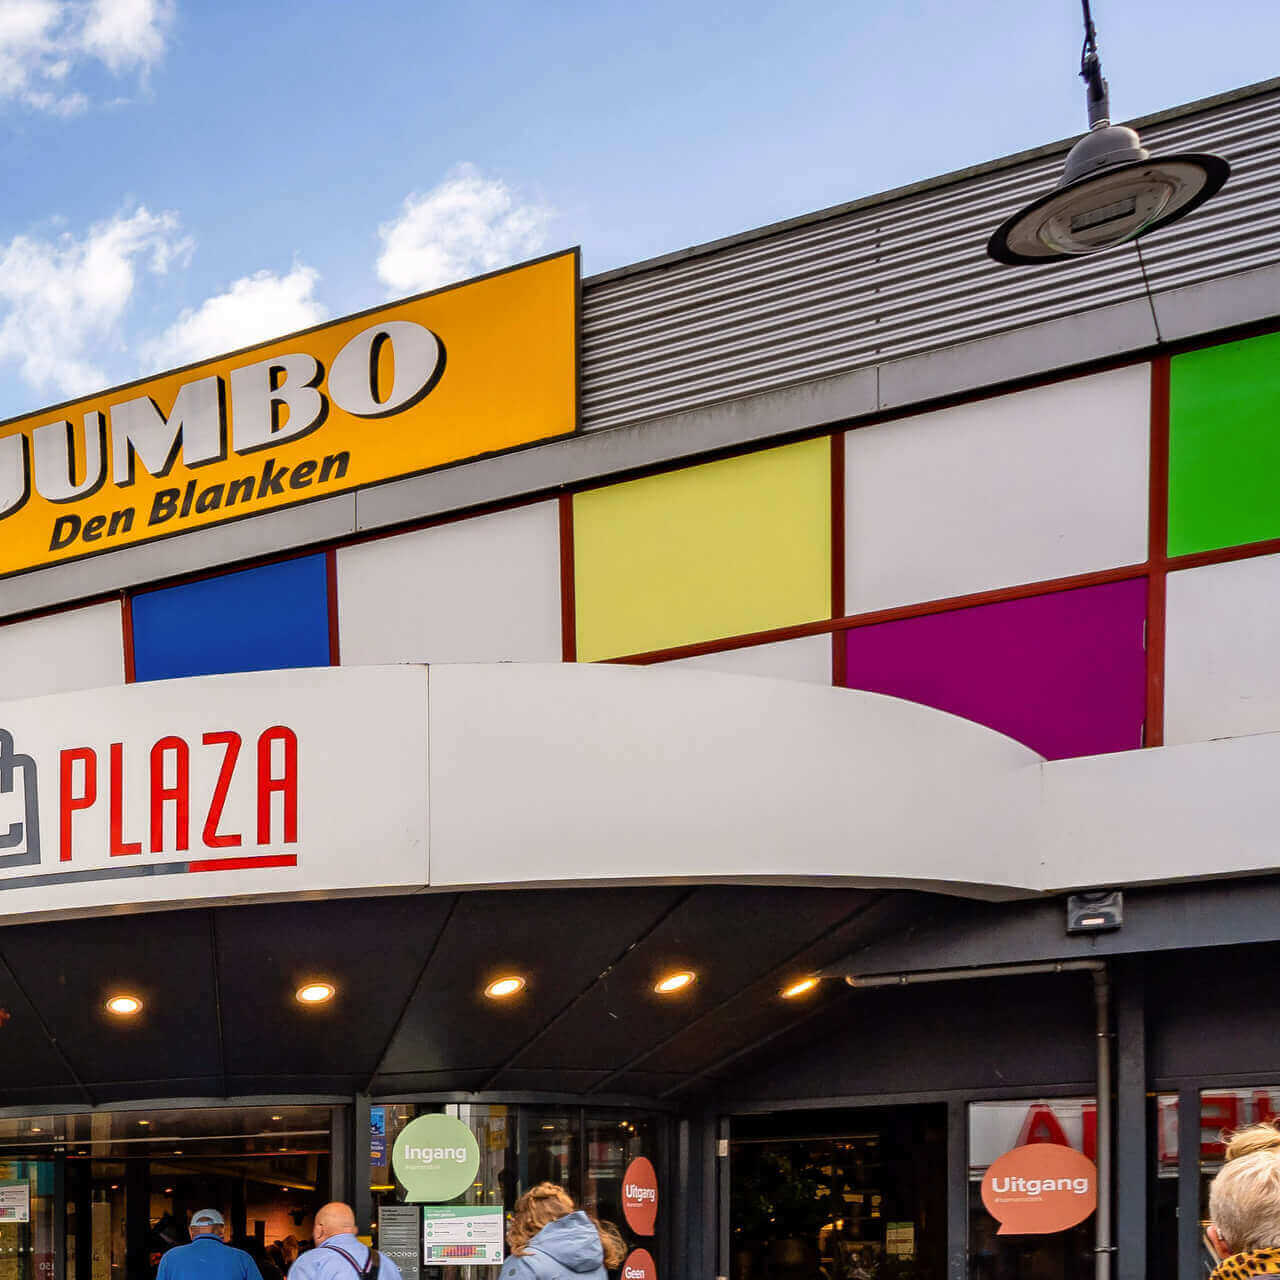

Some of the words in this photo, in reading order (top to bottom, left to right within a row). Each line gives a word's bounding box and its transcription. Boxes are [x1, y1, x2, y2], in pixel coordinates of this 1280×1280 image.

[47, 502, 135, 552] Den
[146, 449, 351, 528] Blanken
[59, 725, 298, 863] PLAZA
[404, 1144, 467, 1164] Ingang
[625, 1183, 657, 1203] Uitgang
[991, 1176, 1088, 1196] Uitgang
[624, 1265, 645, 1280] Geen
